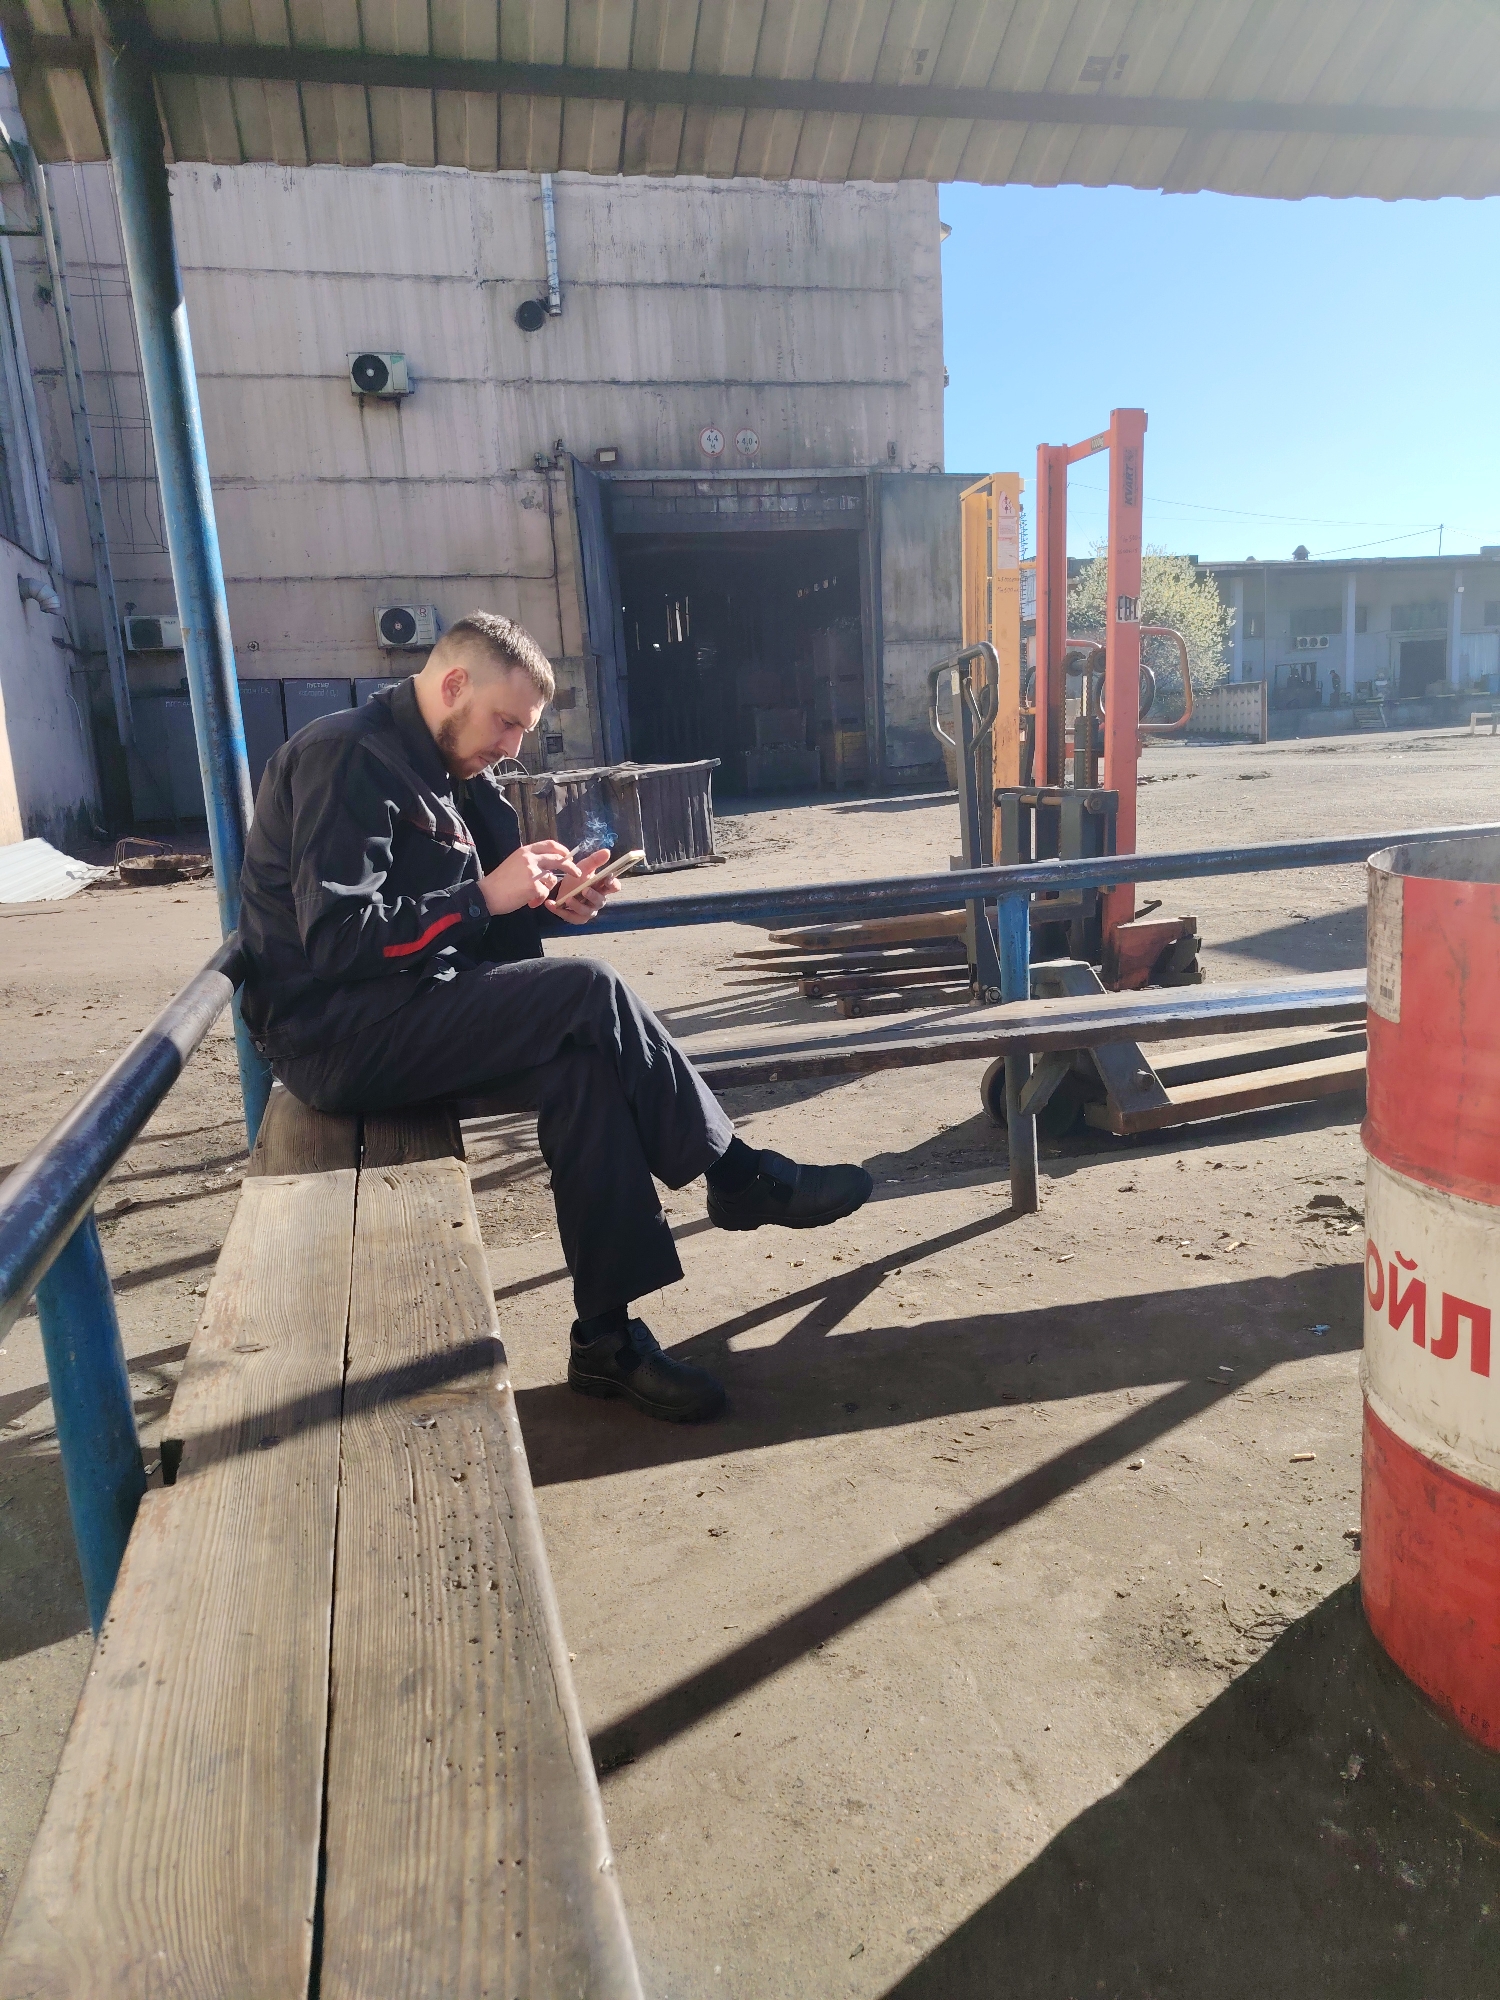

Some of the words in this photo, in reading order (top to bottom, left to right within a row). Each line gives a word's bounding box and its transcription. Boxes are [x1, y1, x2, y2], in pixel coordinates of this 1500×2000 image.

[706, 434, 718, 444] 4,4
[741, 437, 753, 446] 4,0
[1124, 463, 1134, 506] KVART
[1365, 1237, 1491, 1378] ОЙЛ
